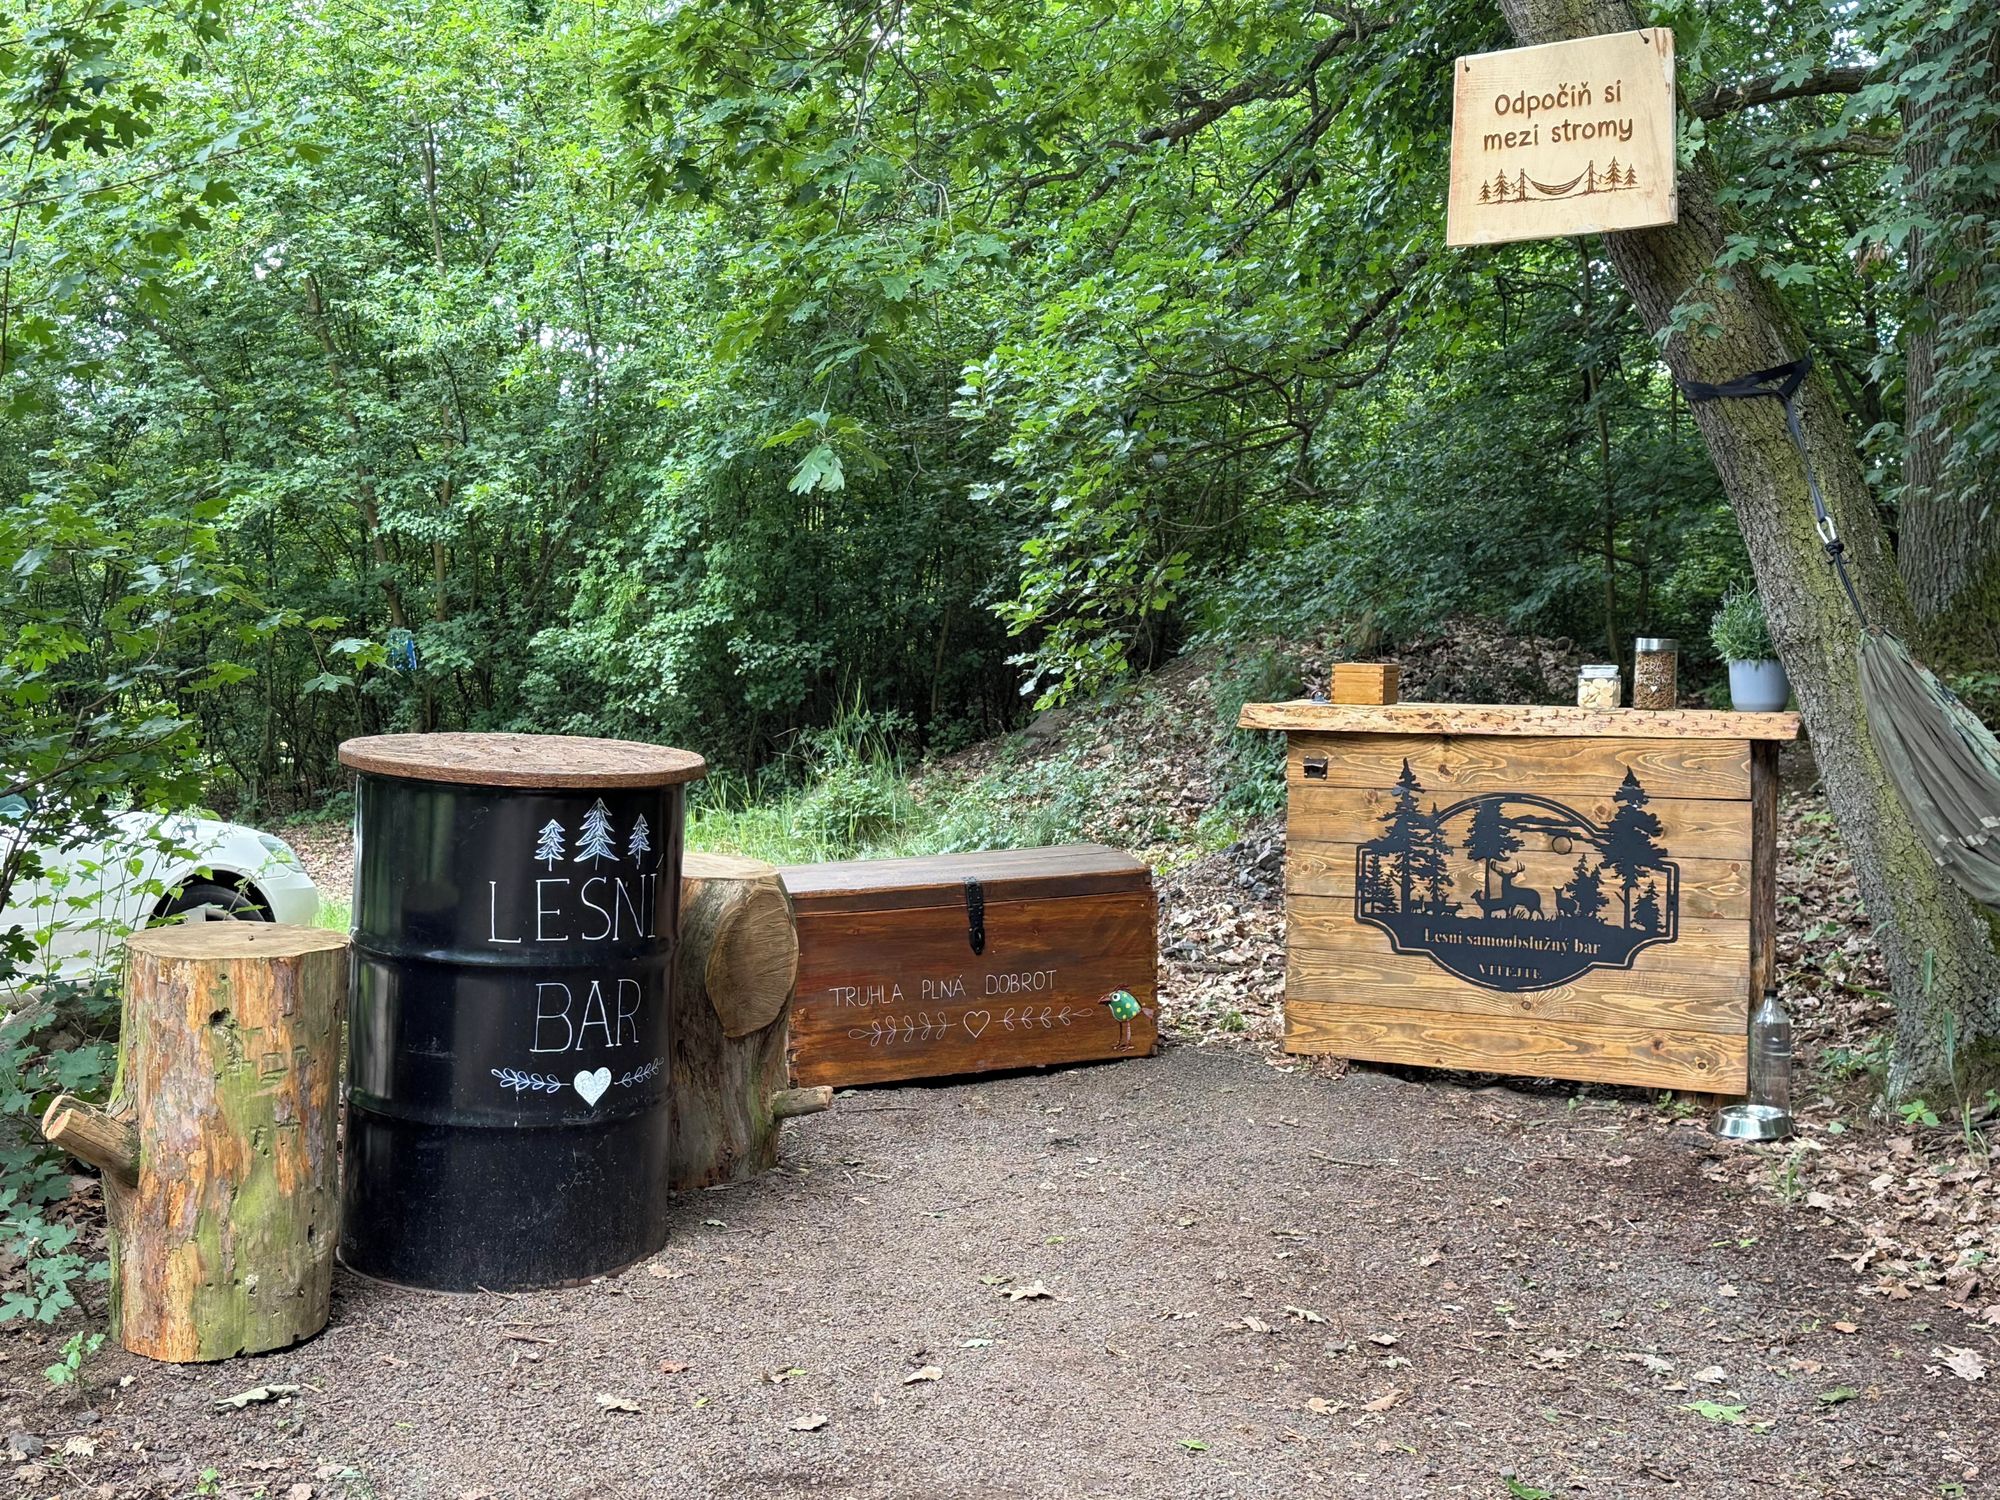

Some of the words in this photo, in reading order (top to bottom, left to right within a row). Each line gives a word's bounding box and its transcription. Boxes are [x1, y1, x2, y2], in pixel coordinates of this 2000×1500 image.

[1494, 81, 1592, 118] Odpočiň
[1604, 79, 1622, 104] si
[1483, 124, 1539, 151] mezi
[1551, 117, 1633, 142] stromy
[1643, 661, 1664, 672] PRO
[488, 853, 664, 943] LESNÍ
[1466, 934, 1570, 956] samoobslužný
[1574, 938, 1601, 954] bar
[829, 983, 905, 1007] TRUHLA
[921, 974, 967, 1000] PLNÁ
[985, 969, 1057, 996] DOBROT
[529, 978, 641, 1052] BAR
